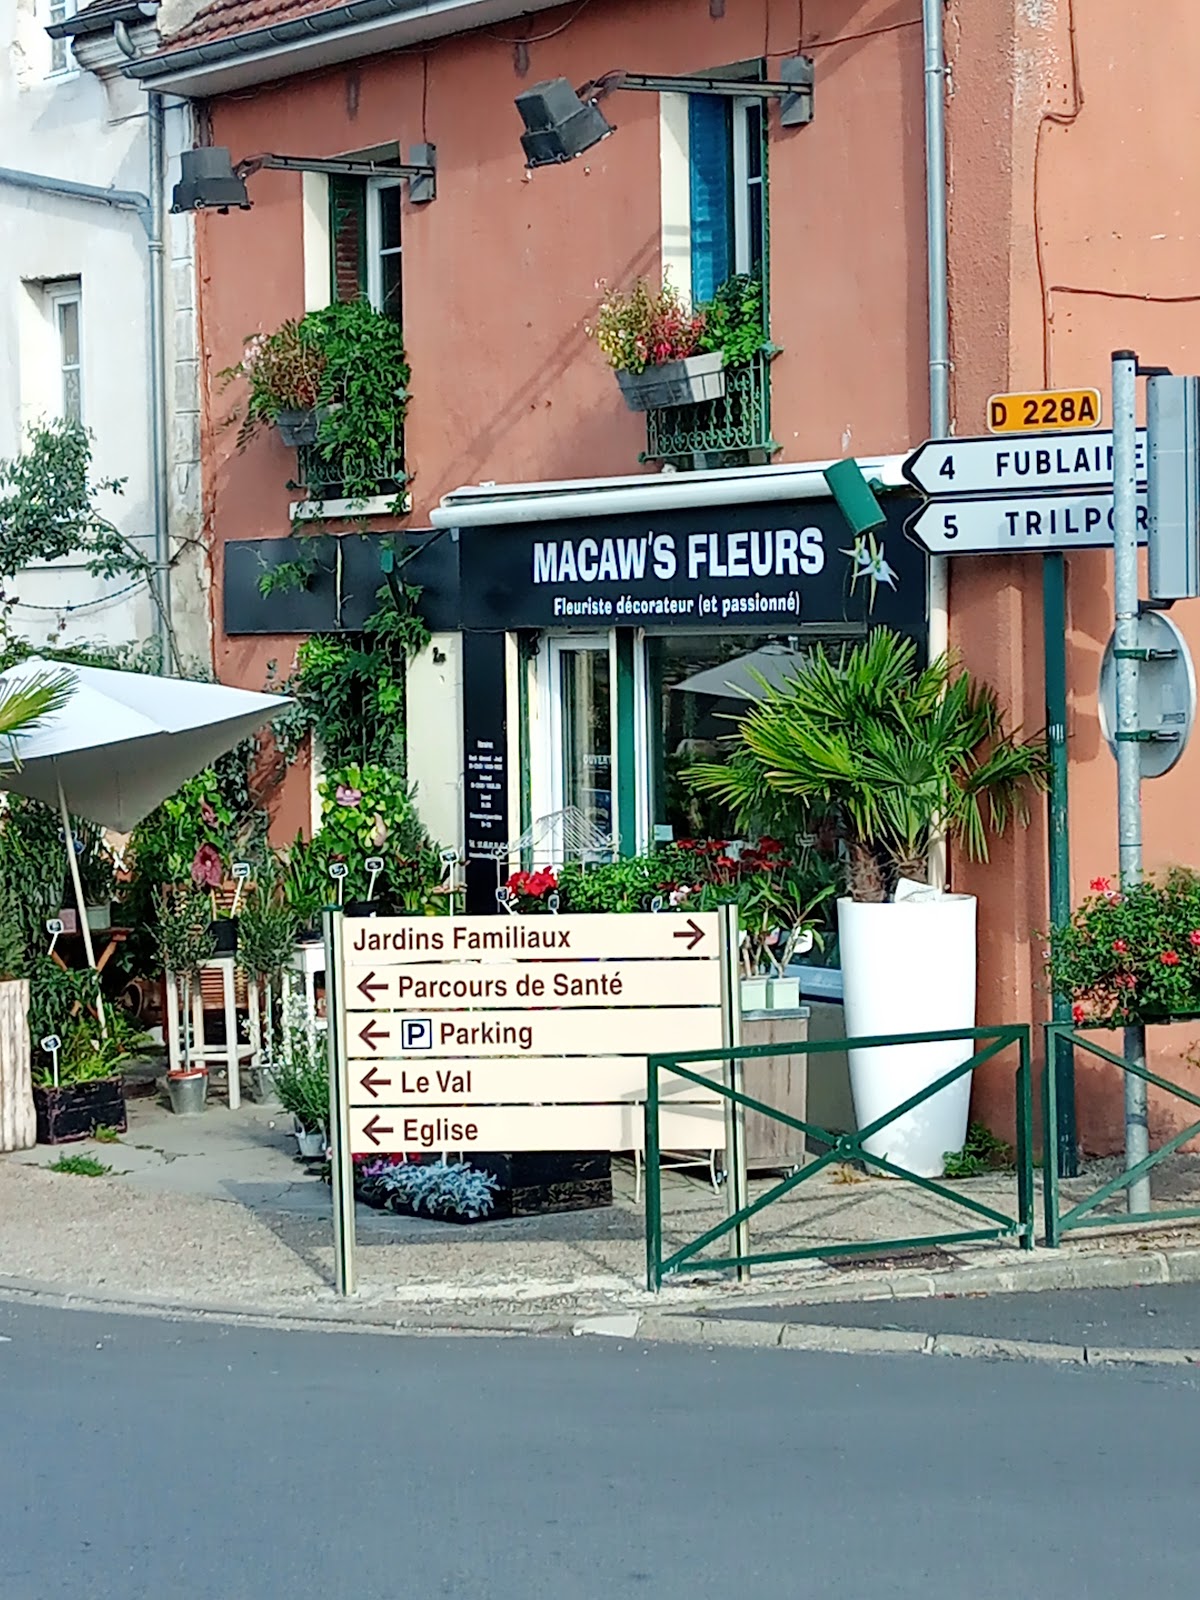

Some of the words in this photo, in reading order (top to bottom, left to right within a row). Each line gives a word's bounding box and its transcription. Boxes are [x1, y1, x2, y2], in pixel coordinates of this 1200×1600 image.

[992, 402, 1007, 427] D
[1023, 396, 1095, 425] 228A
[939, 455, 955, 480] 4
[943, 515, 959, 539] 5
[533, 531, 677, 583] MACAW'S
[688, 527, 825, 579] FLEURS
[553, 595, 612, 616] Fleuriste
[616, 594, 694, 614] décorateur
[698, 593, 718, 617] (et
[722, 590, 801, 618] passionné)
[353, 928, 444, 950] Jardins
[453, 926, 571, 950] Familiaux
[398, 975, 507, 998] Parcours
[516, 974, 545, 997] de
[553, 971, 623, 996] Santé
[407, 1023, 425, 1045] P
[440, 1022, 533, 1049] Parking
[401, 1071, 430, 1093] Le
[436, 1070, 472, 1092] Val
[403, 1118, 479, 1147] Eglise
